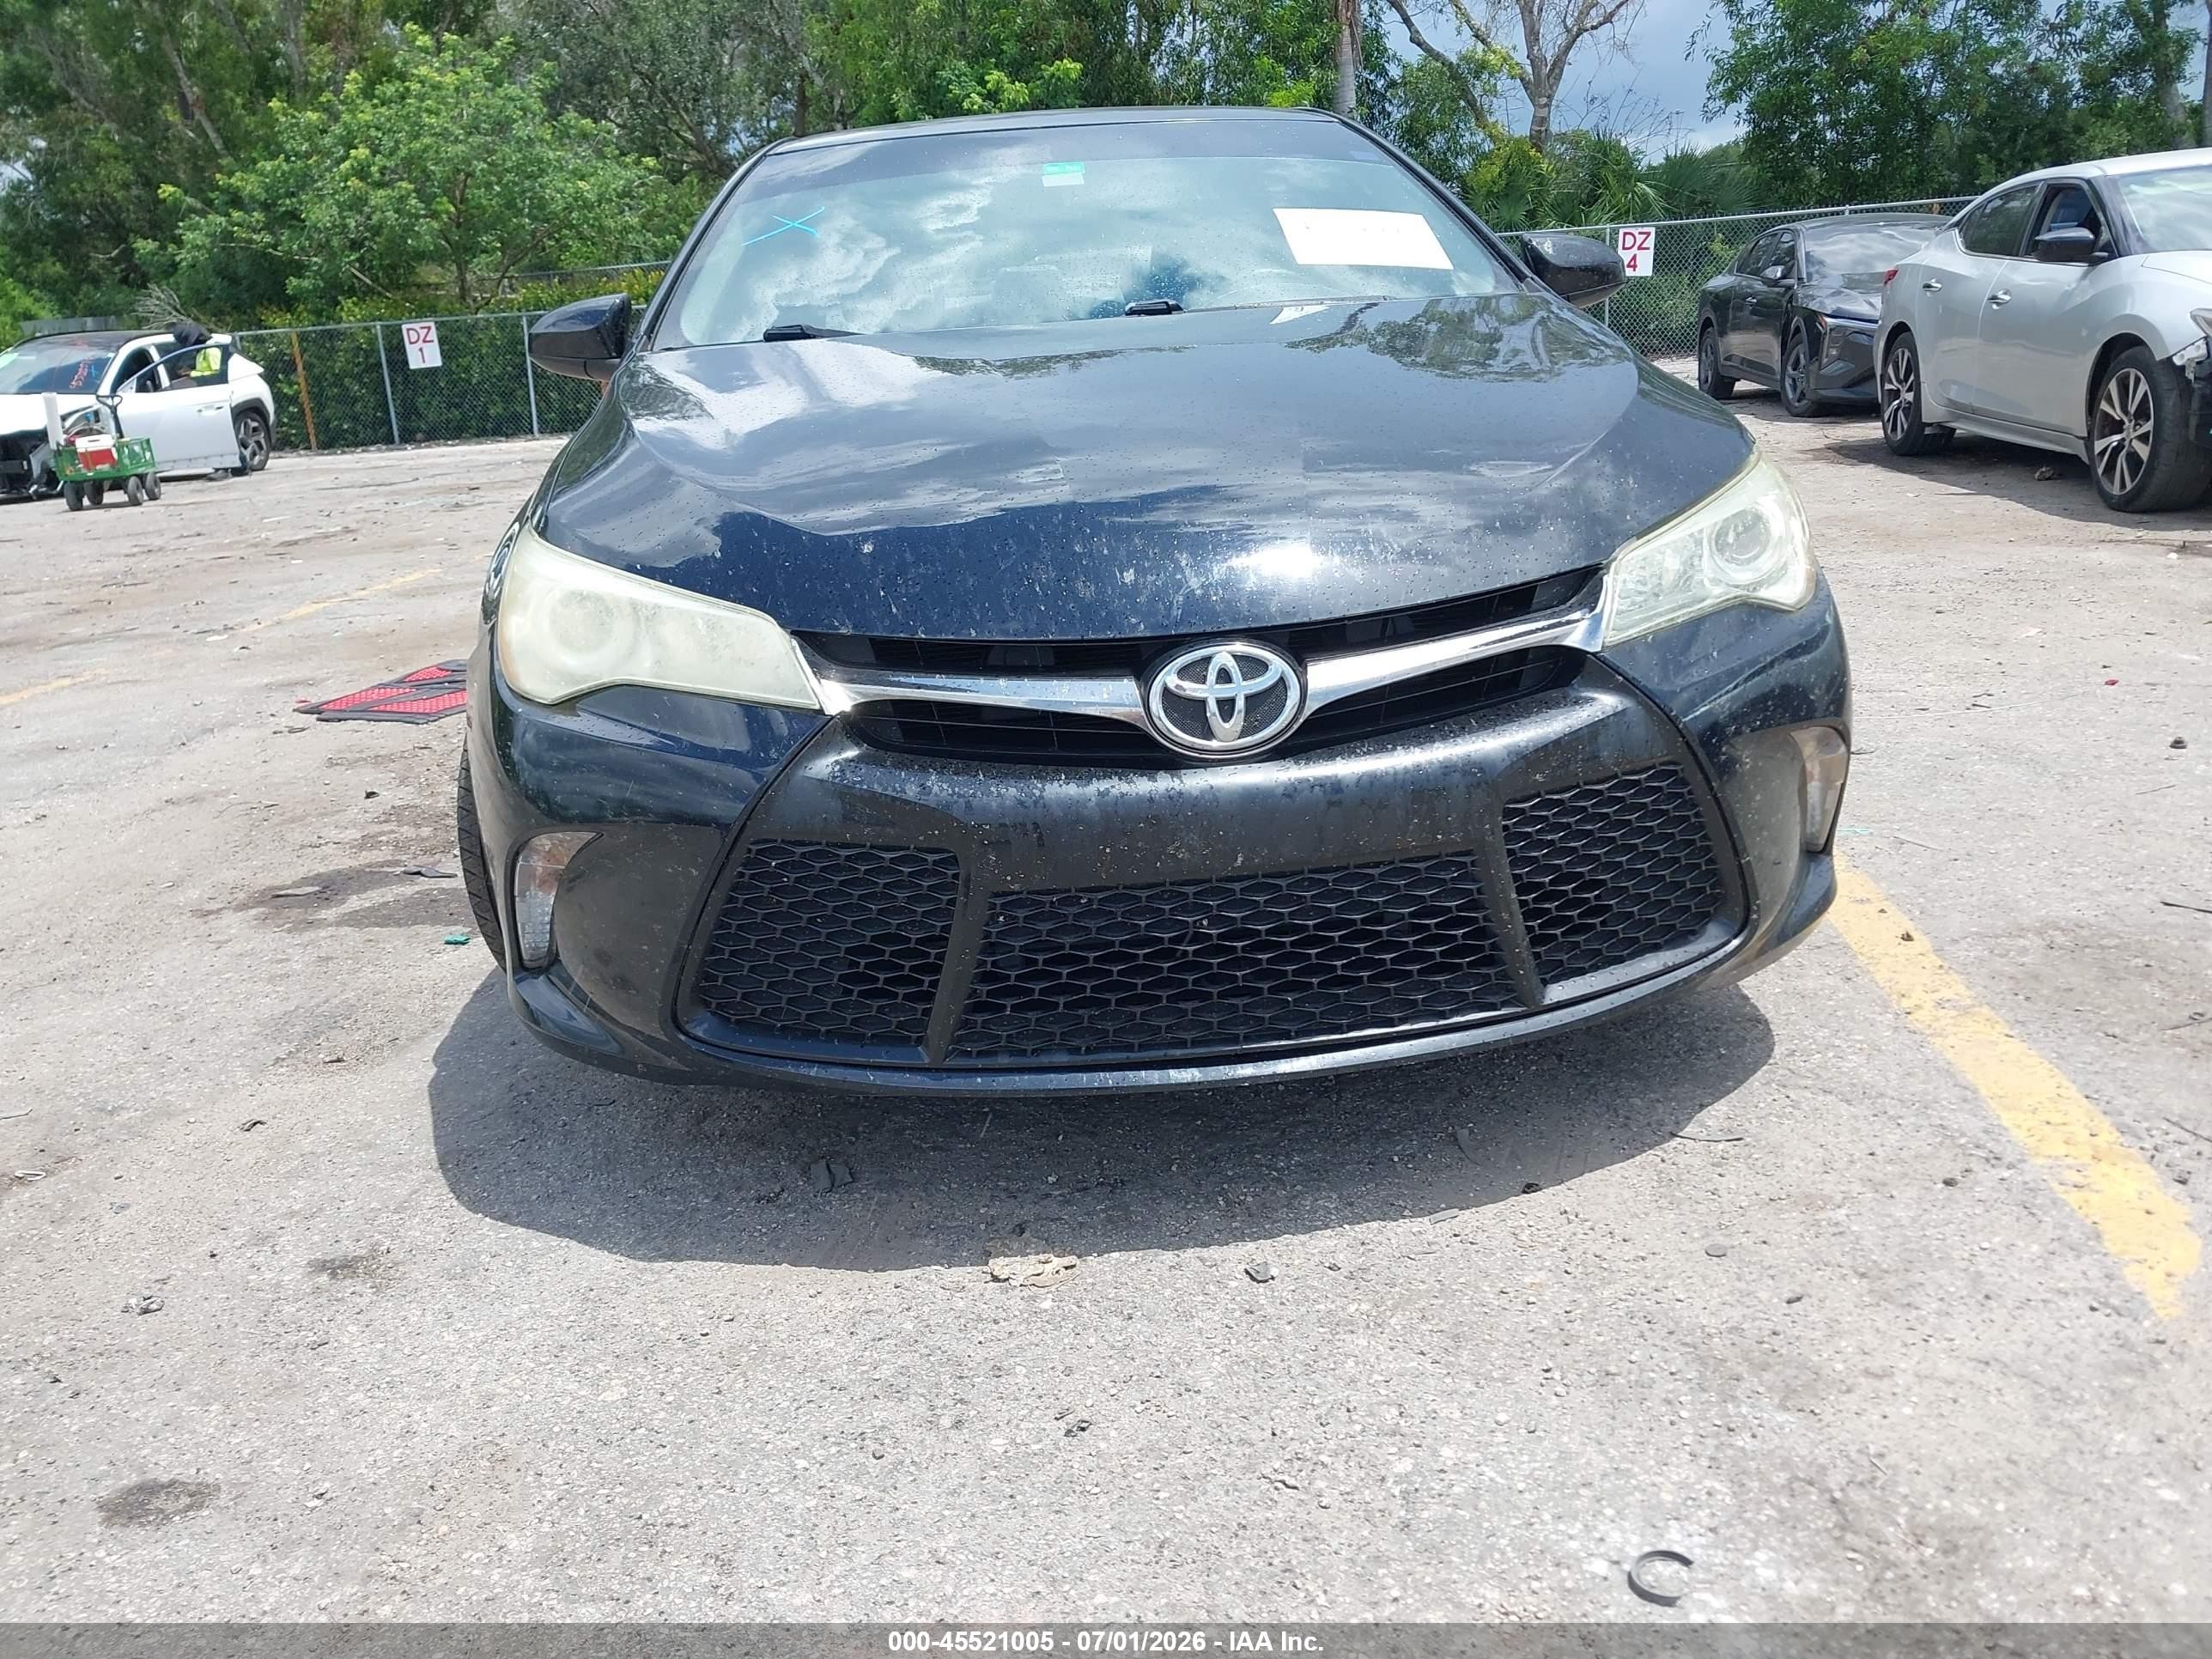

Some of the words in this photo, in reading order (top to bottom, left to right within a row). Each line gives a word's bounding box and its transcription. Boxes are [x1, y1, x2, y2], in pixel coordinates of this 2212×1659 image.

[1622, 231, 1651, 251] DZ
[1626, 253, 1638, 272] 4
[406, 326, 434, 344] DZ
[418, 347, 426, 364] 1
